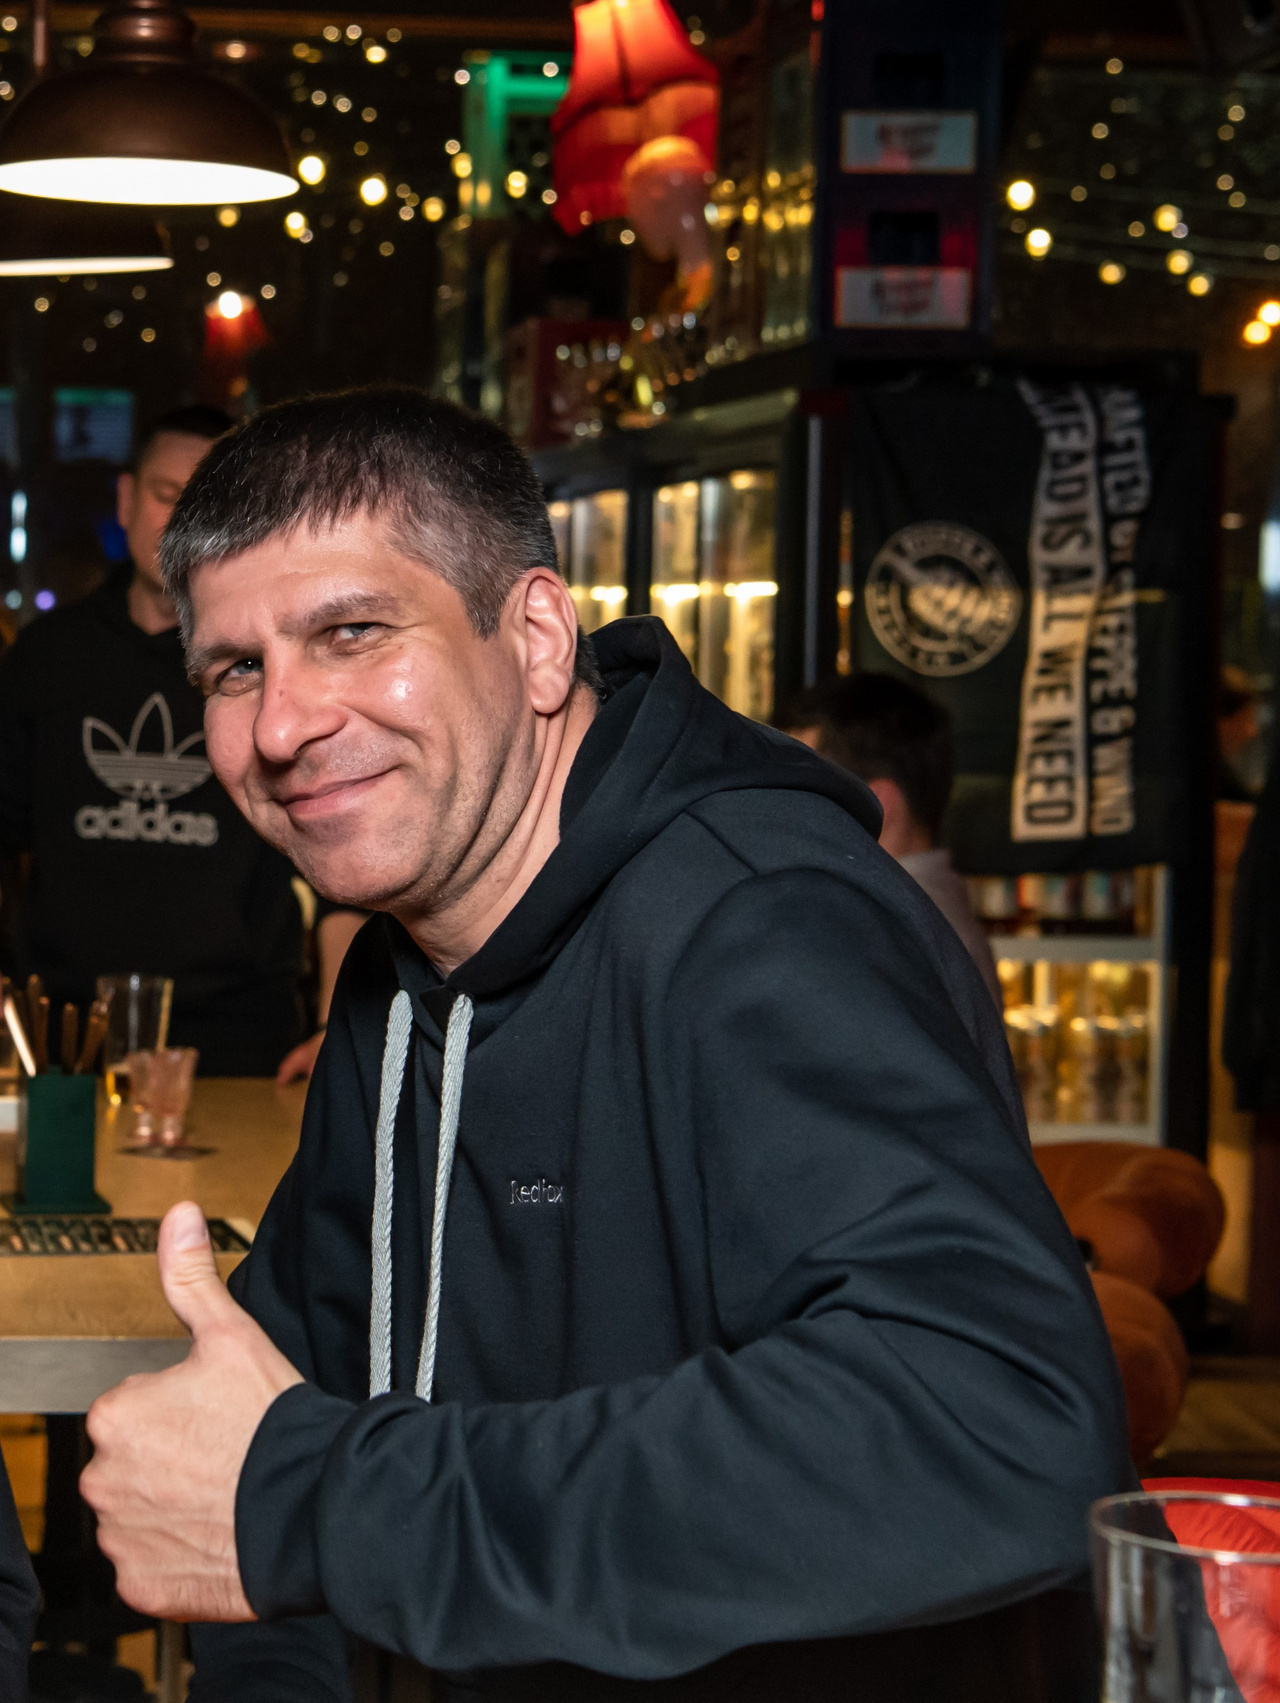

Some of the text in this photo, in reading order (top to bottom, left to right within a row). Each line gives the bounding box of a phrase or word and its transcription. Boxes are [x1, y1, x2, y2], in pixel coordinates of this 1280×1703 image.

[1041, 513, 1092, 551] IS
[1042, 563, 1094, 634] ALL
[1031, 644, 1075, 704] WE
[1024, 718, 1076, 825] NEED
[74, 799, 219, 847] adidas
